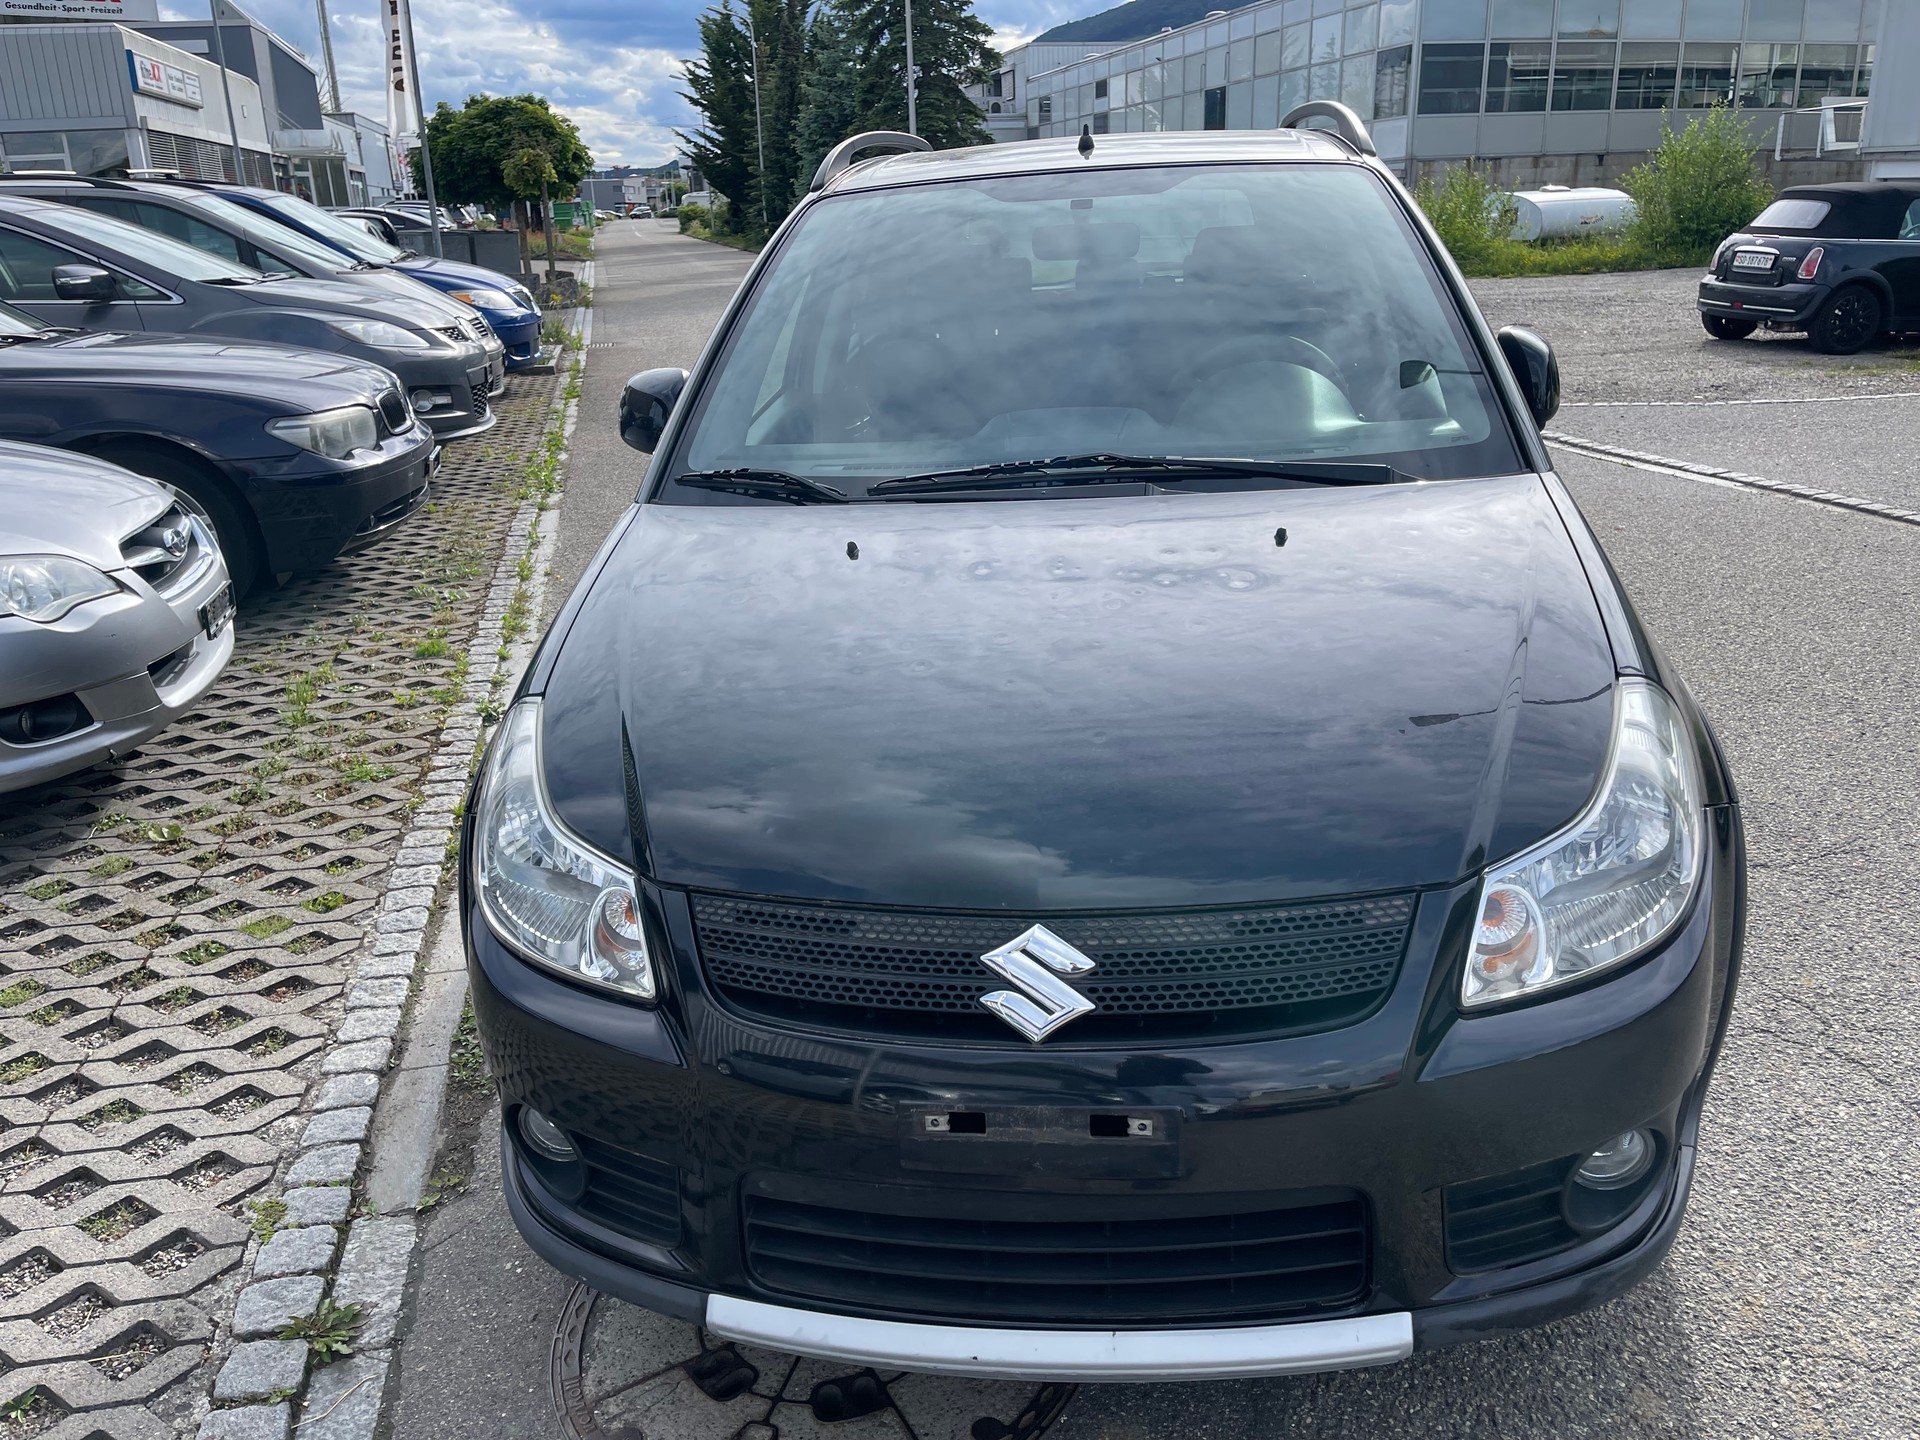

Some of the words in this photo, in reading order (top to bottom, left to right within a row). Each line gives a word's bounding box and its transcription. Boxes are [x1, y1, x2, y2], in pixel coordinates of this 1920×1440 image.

[5, 2, 57, 11] Gesundheit
[62, 5, 85, 13] Sport
[90, 6, 123, 14] Freizeit
